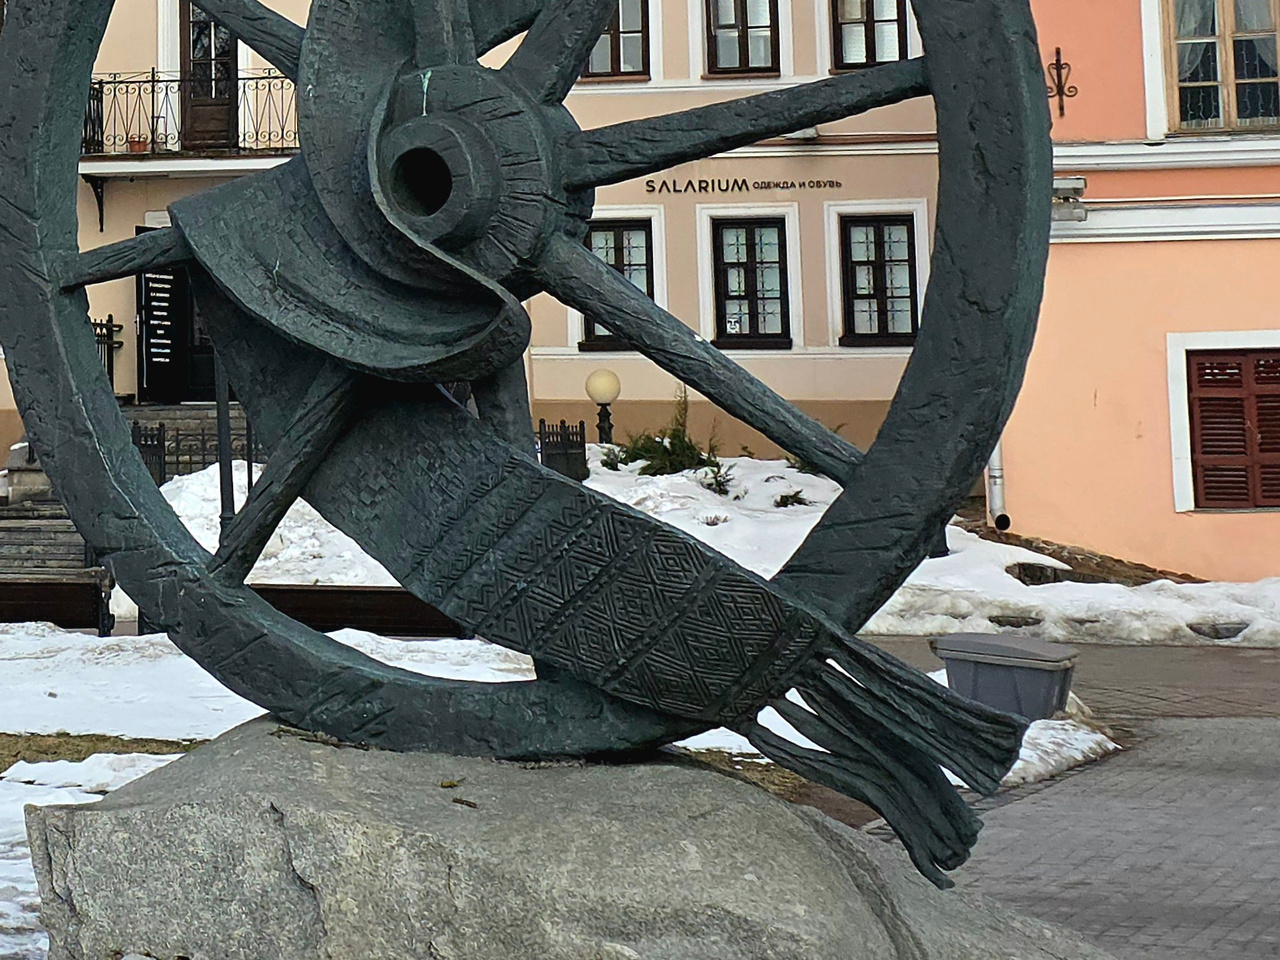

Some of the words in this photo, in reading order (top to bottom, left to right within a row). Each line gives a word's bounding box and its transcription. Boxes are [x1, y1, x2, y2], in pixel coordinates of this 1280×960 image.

[645, 178, 750, 194] SALARIUM
[752, 180, 797, 190] ОДЕЖДА
[799, 180, 806, 189] И
[807, 180, 843, 189] ОБУВЬ
